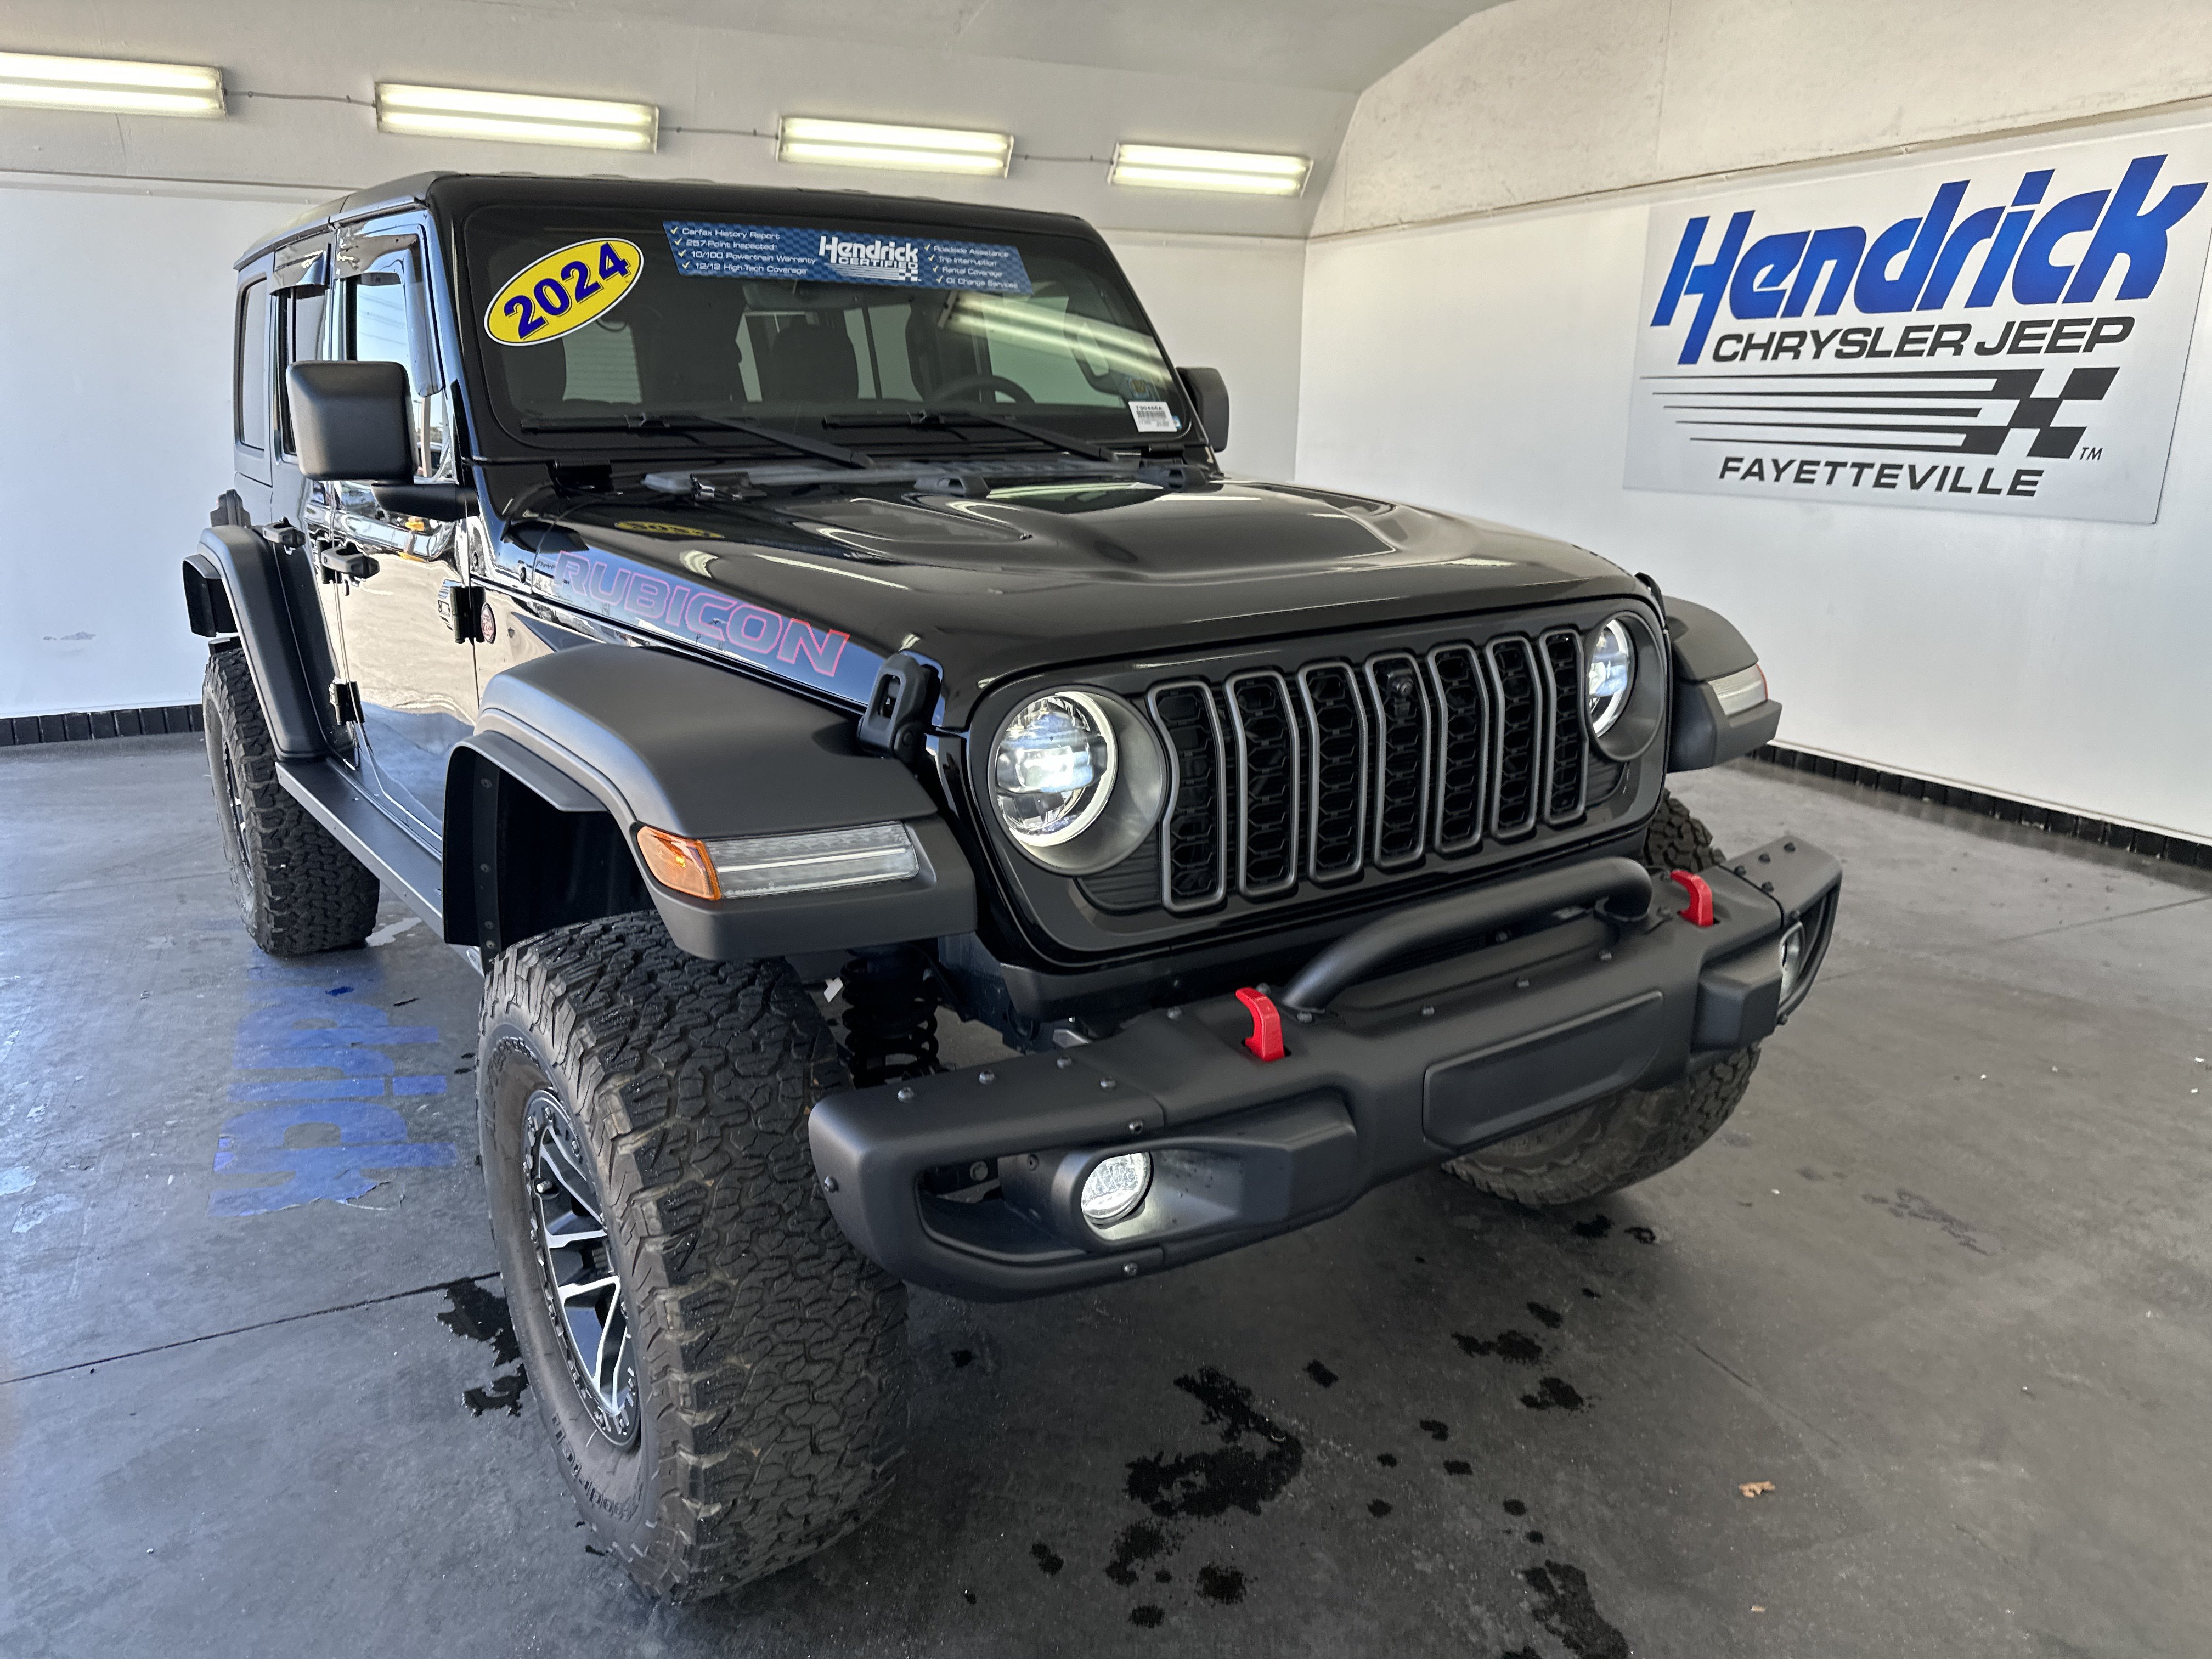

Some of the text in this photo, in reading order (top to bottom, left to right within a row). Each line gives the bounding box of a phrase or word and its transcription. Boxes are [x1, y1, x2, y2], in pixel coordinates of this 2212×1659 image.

[682, 228, 780, 240] Carfax History Report
[733, 242, 775, 251] Inspected
[819, 235, 918, 264] Hendrick
[691, 251, 724, 259] 10/100
[726, 252, 774, 261] Powertrain
[838, 256, 918, 269] CERTIFIED
[954, 257, 997, 267] Interruption
[1650, 154, 2208, 365] Hendrick
[724, 264, 764, 273] High-Tech
[766, 265, 808, 275] Coverage
[958, 278, 985, 287] Change
[504, 242, 631, 340] 2024
[1713, 315, 2135, 363] CHRYSLER JEEP
[2080, 447, 2103, 462] TM
[1719, 456, 2044, 498] FAYETTEVILLE
[554, 550, 850, 677] RUBICON
